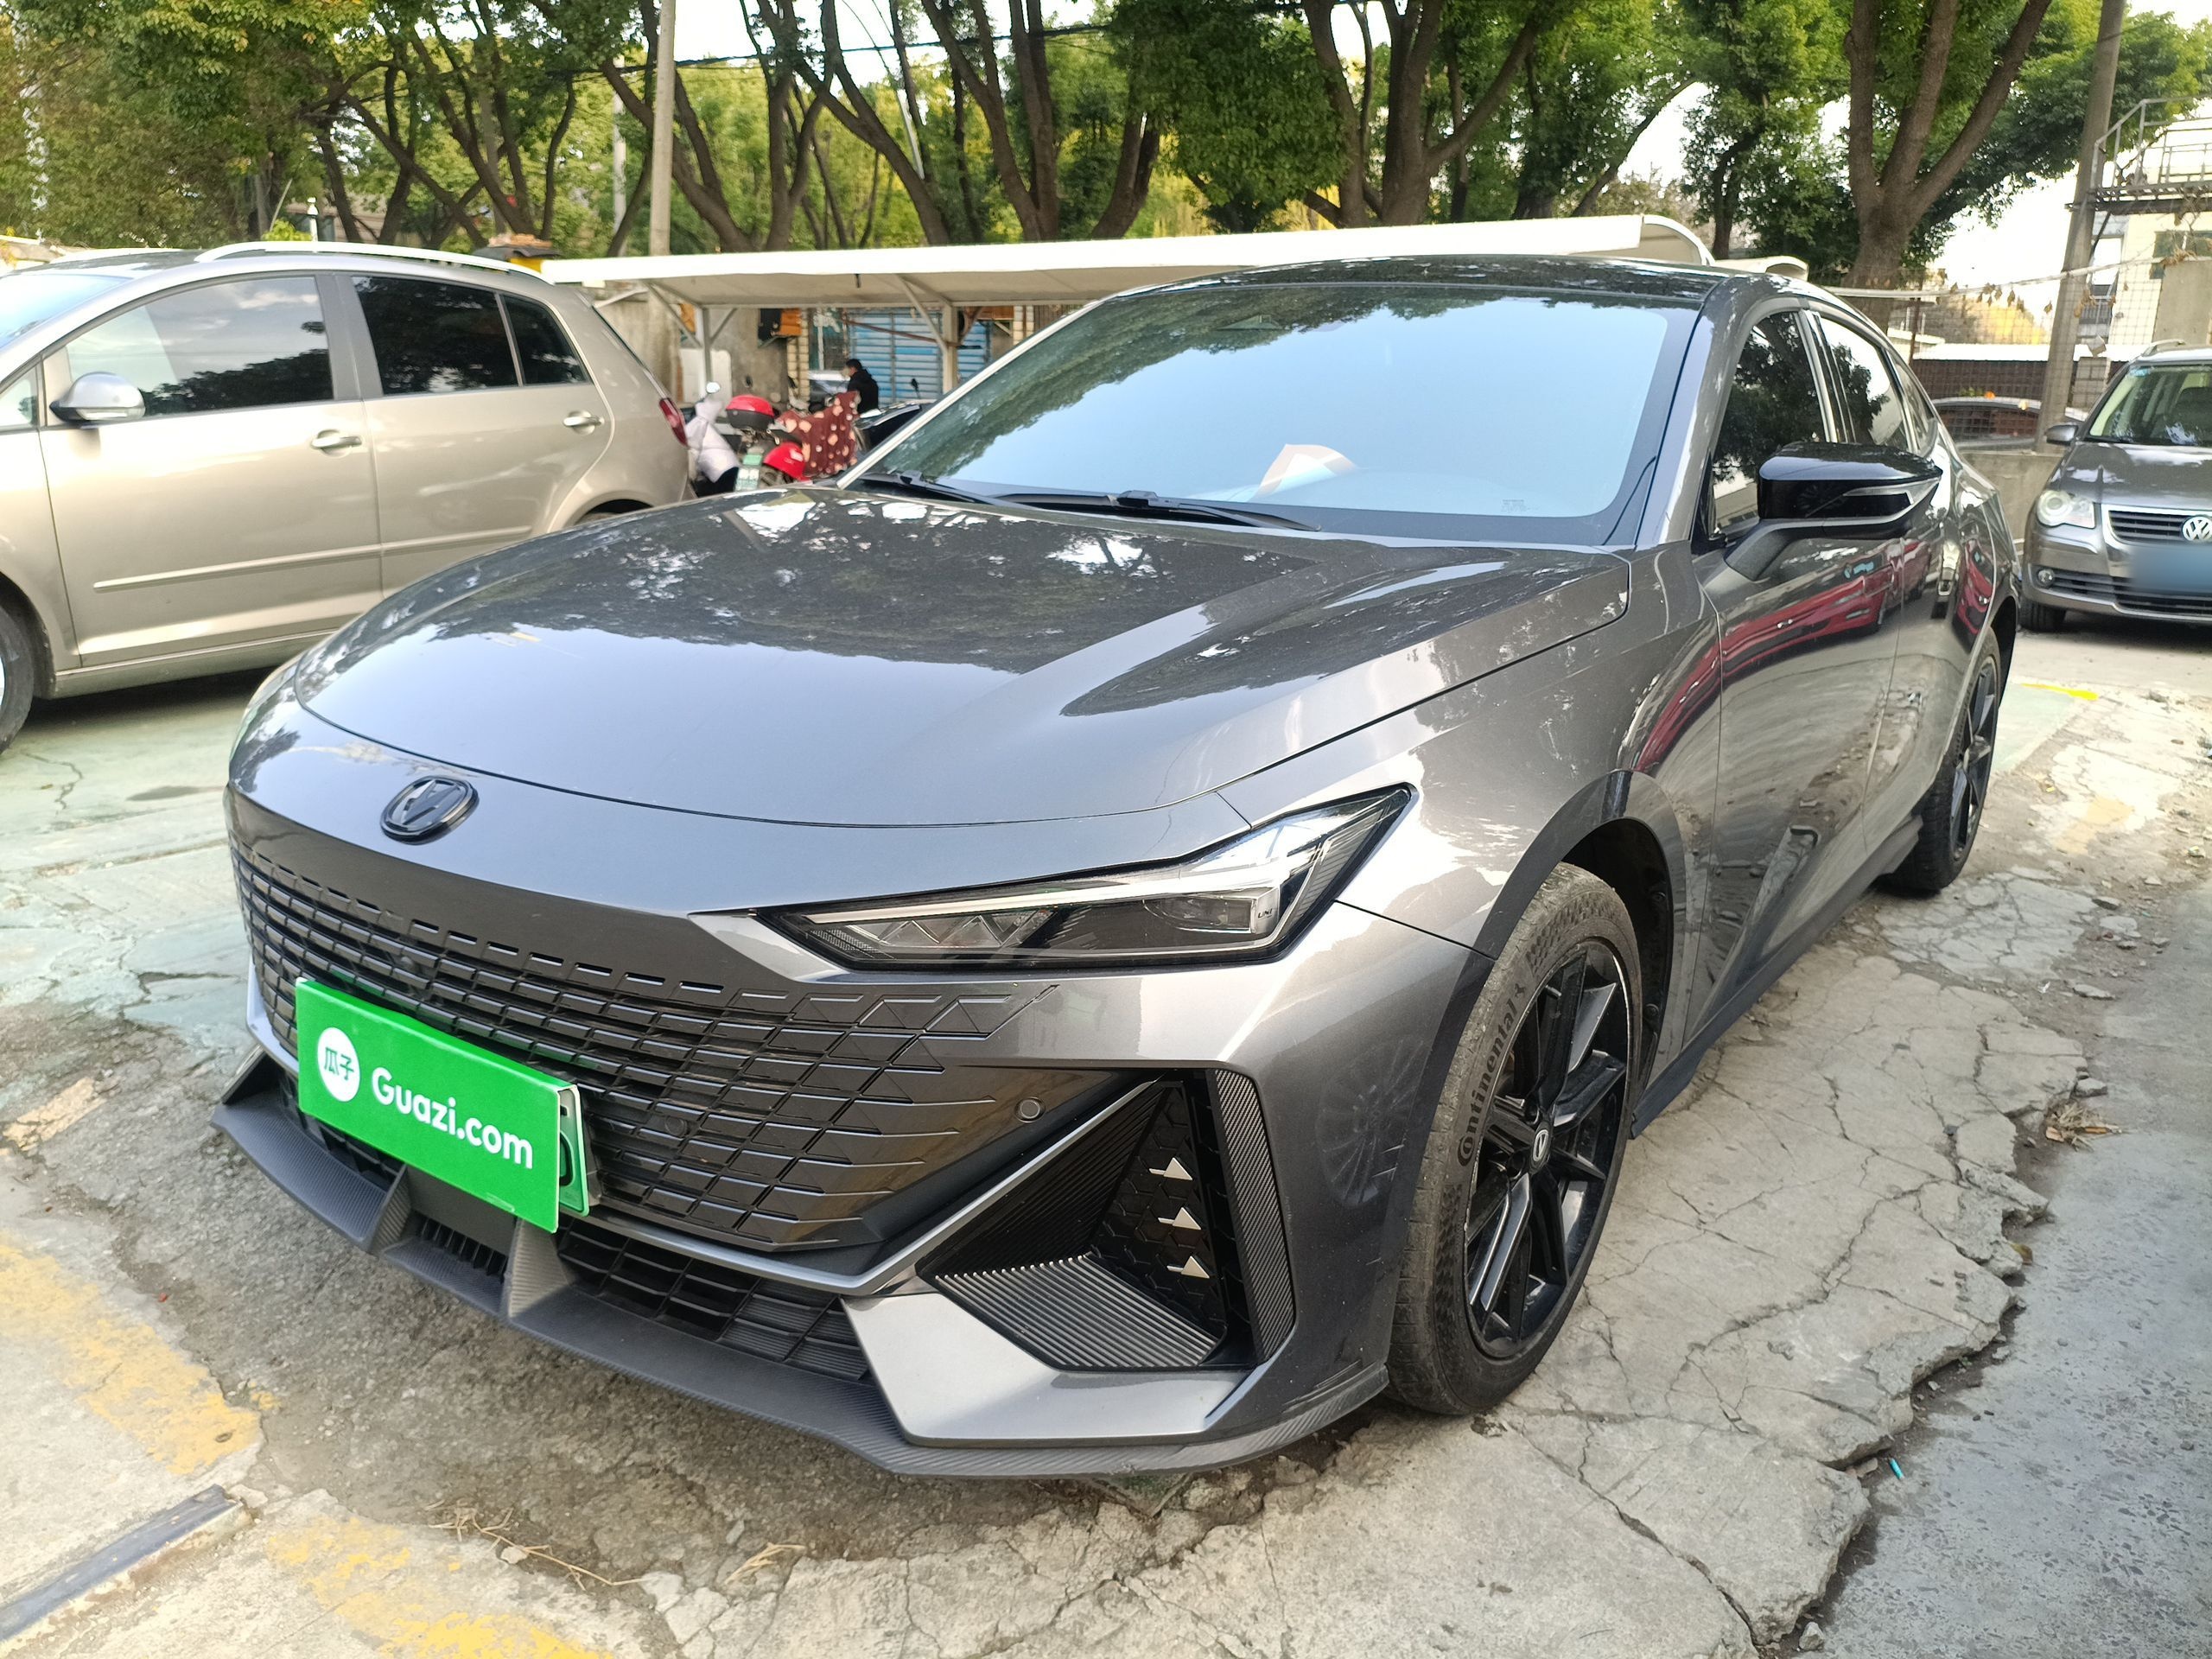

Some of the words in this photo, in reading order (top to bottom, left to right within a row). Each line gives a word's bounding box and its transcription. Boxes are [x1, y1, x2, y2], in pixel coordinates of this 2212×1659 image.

[324, 1046, 355, 1081] 瓜子
[1457, 997, 1518, 1166] Continental
[372, 1067, 533, 1169] Guazi.com
